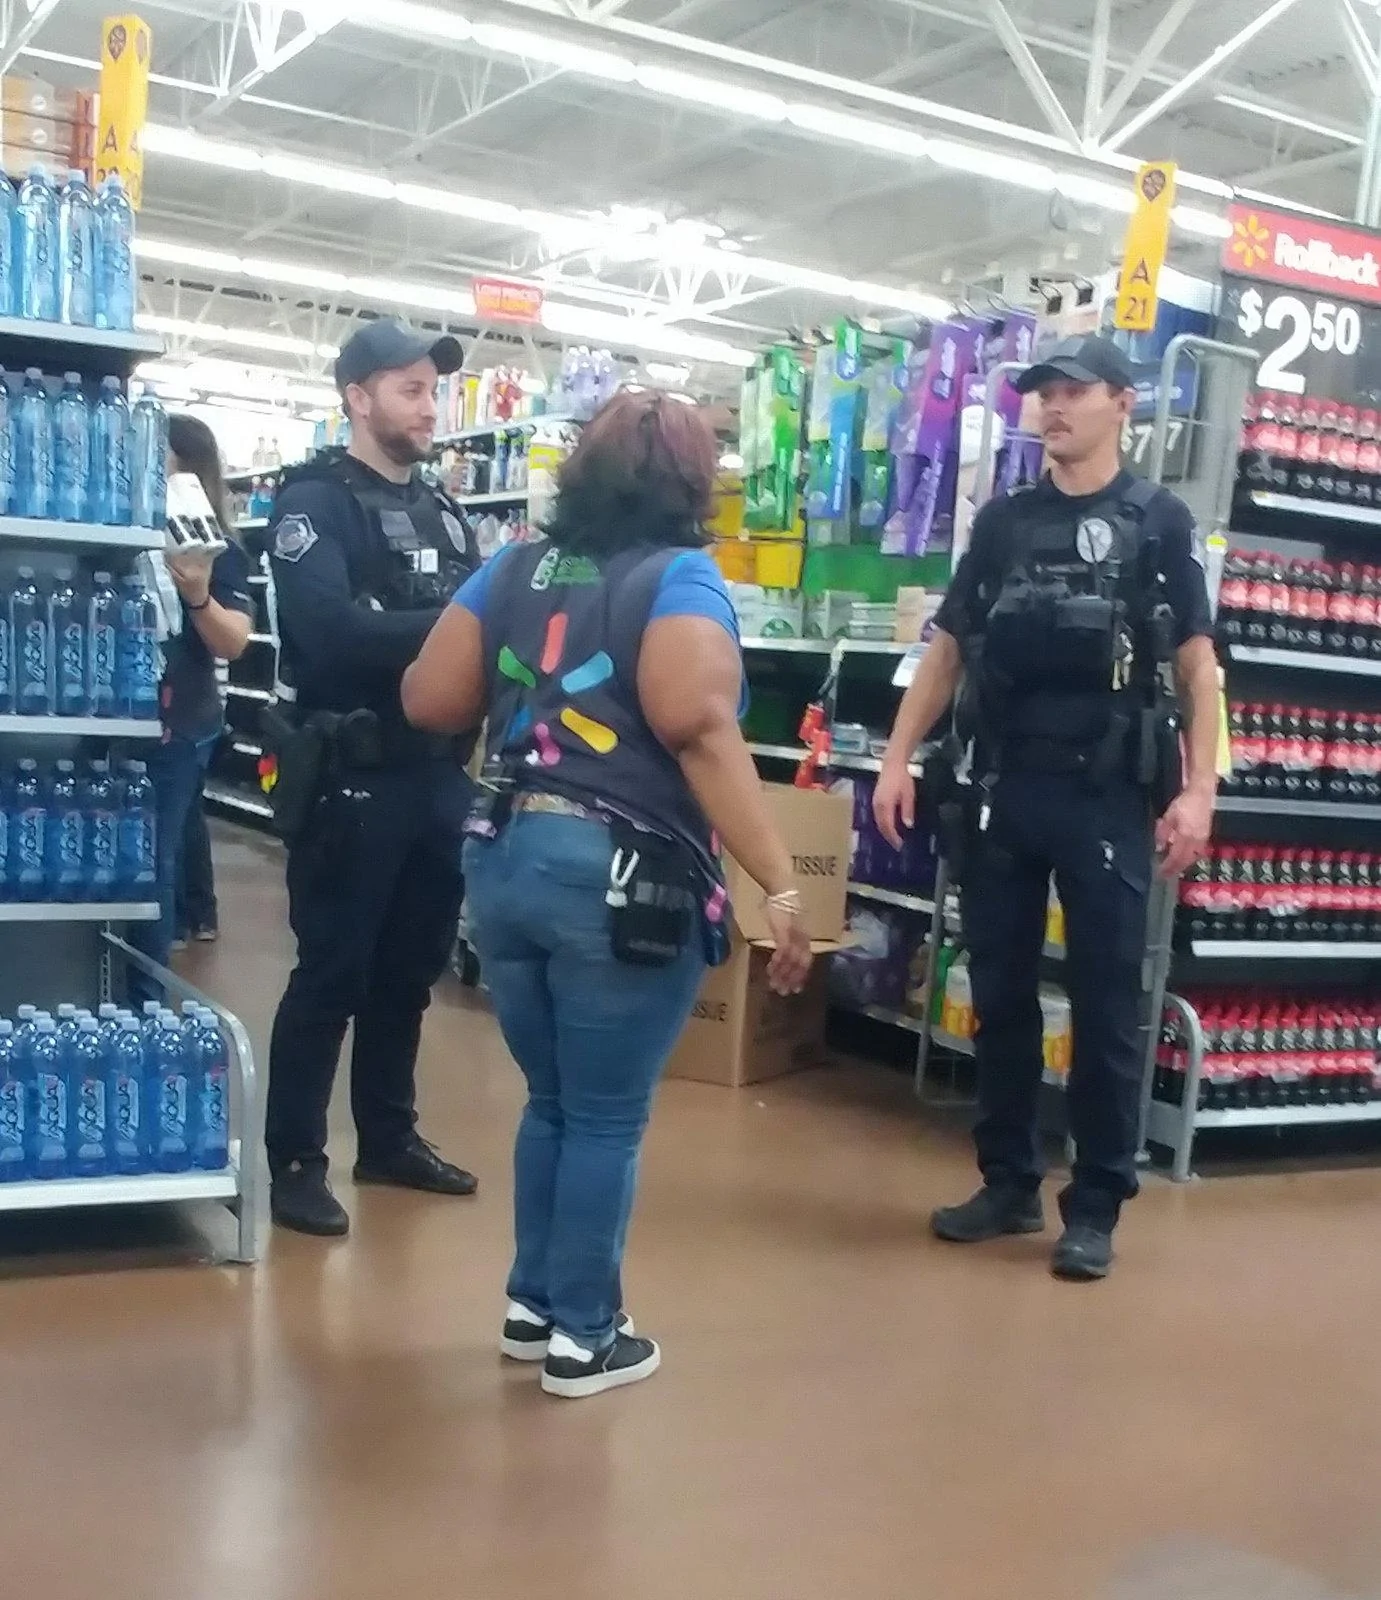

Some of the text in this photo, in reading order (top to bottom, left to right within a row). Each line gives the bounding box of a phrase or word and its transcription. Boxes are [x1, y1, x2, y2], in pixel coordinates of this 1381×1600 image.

[102, 124, 117, 152] A
[1131, 258, 1150, 284] A
[1274, 232, 1379, 287] Rollback
[1123, 297, 1147, 321] 21
[791, 855, 837, 877] TISSUE
